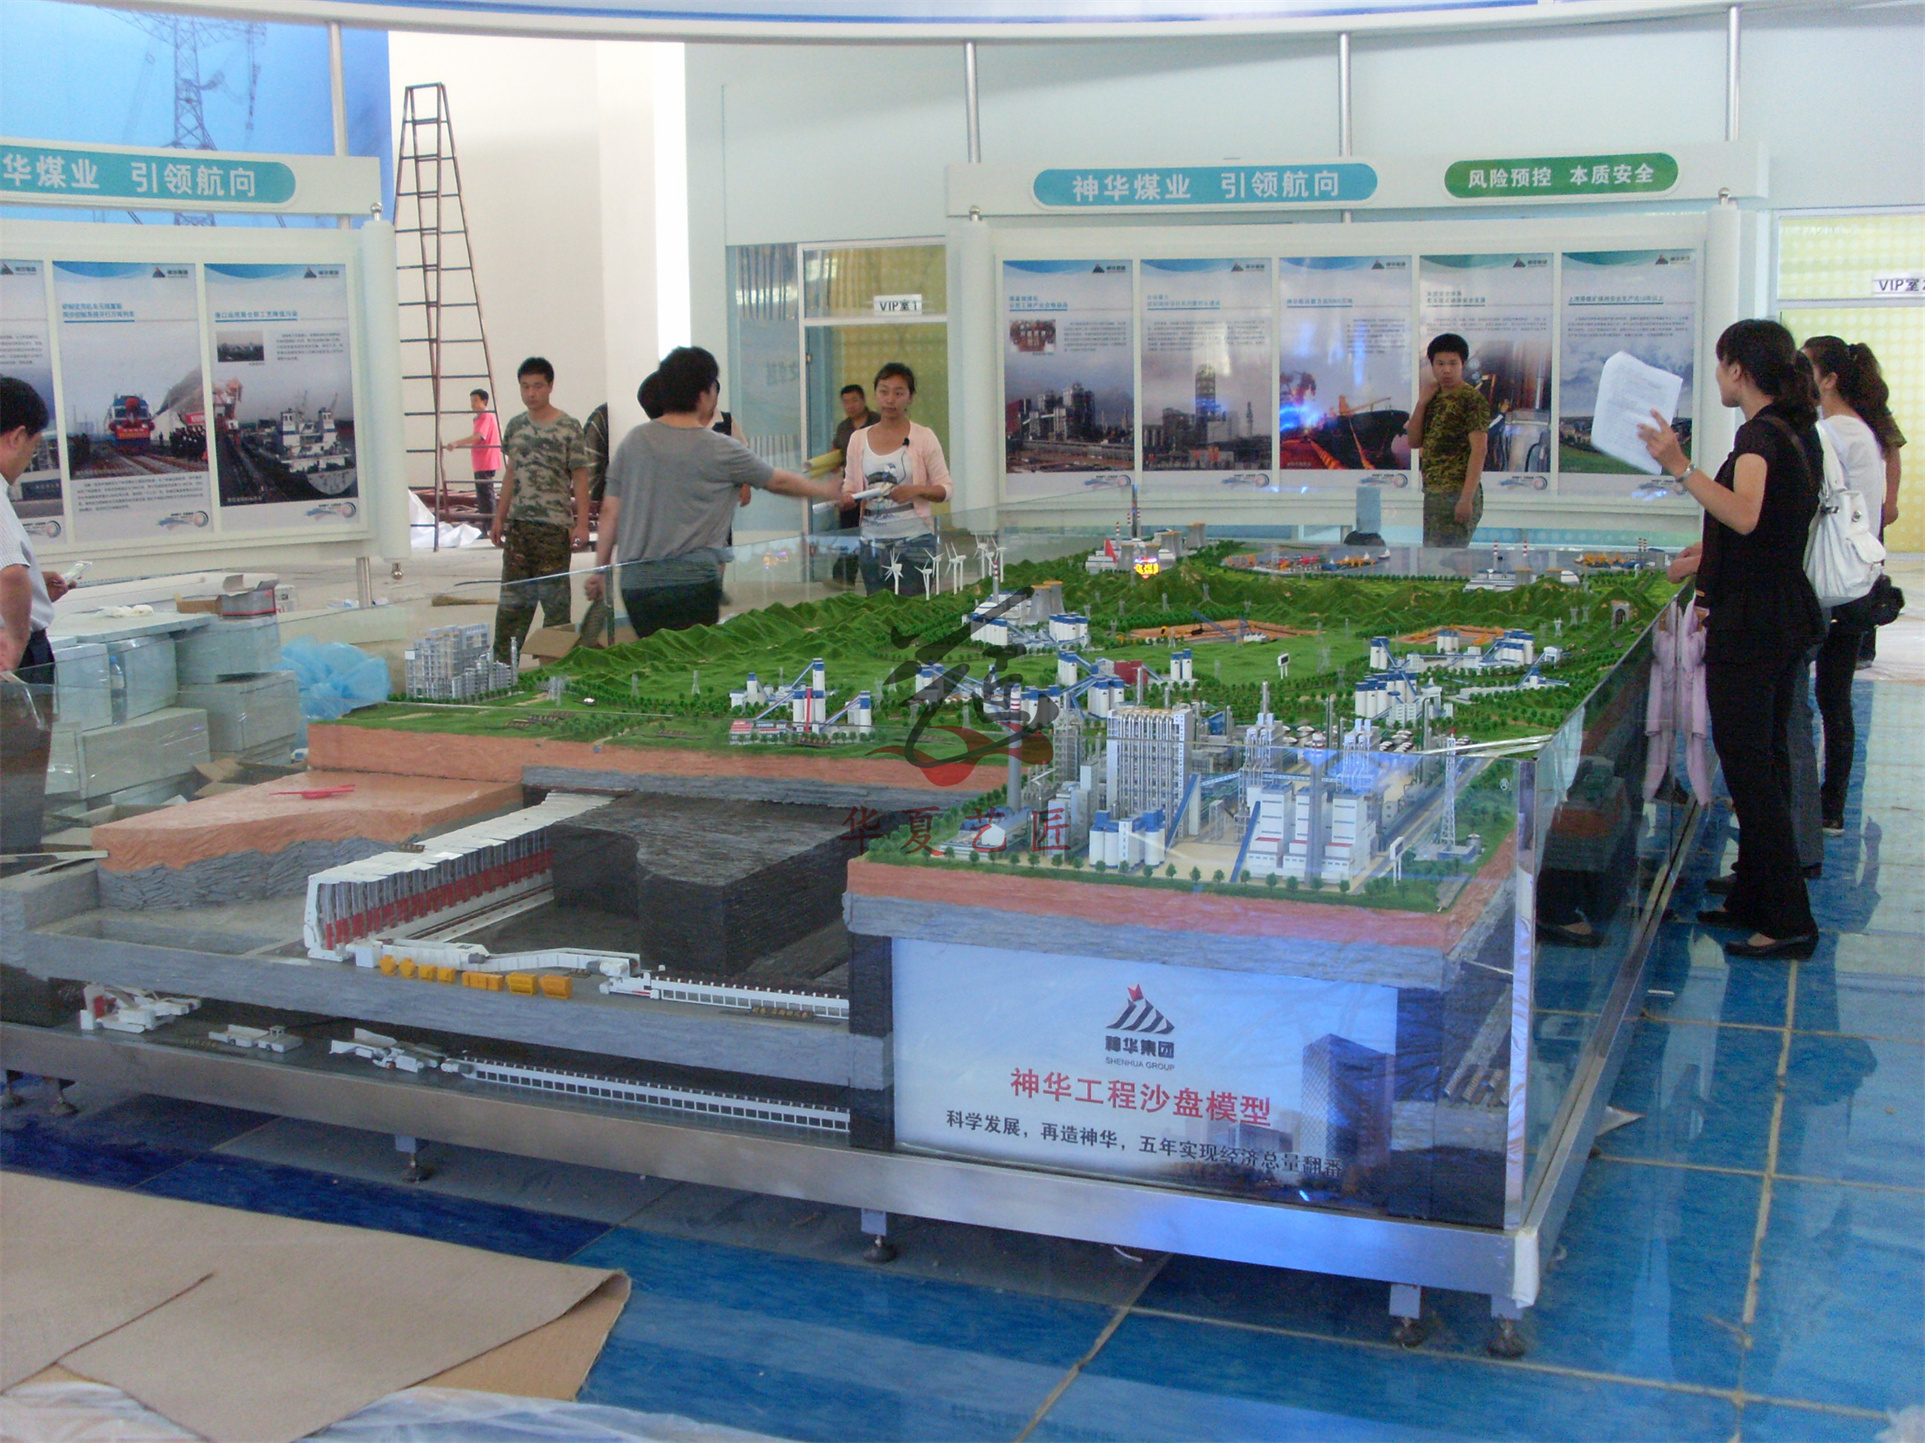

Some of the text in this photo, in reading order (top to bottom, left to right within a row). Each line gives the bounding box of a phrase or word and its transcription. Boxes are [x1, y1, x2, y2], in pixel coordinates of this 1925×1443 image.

[130, 160, 256, 198] 引领航向
[1072, 169, 1340, 202] 神华煤业 引领航向
[1467, 162, 1654, 190] 风险预控 本质安全
[1105, 1035, 1175, 1059] 神华集团
[1105, 1056, 1175, 1071] SHENHUA GROUP
[1010, 1066, 1272, 1128] 神华工程沙盘模型
